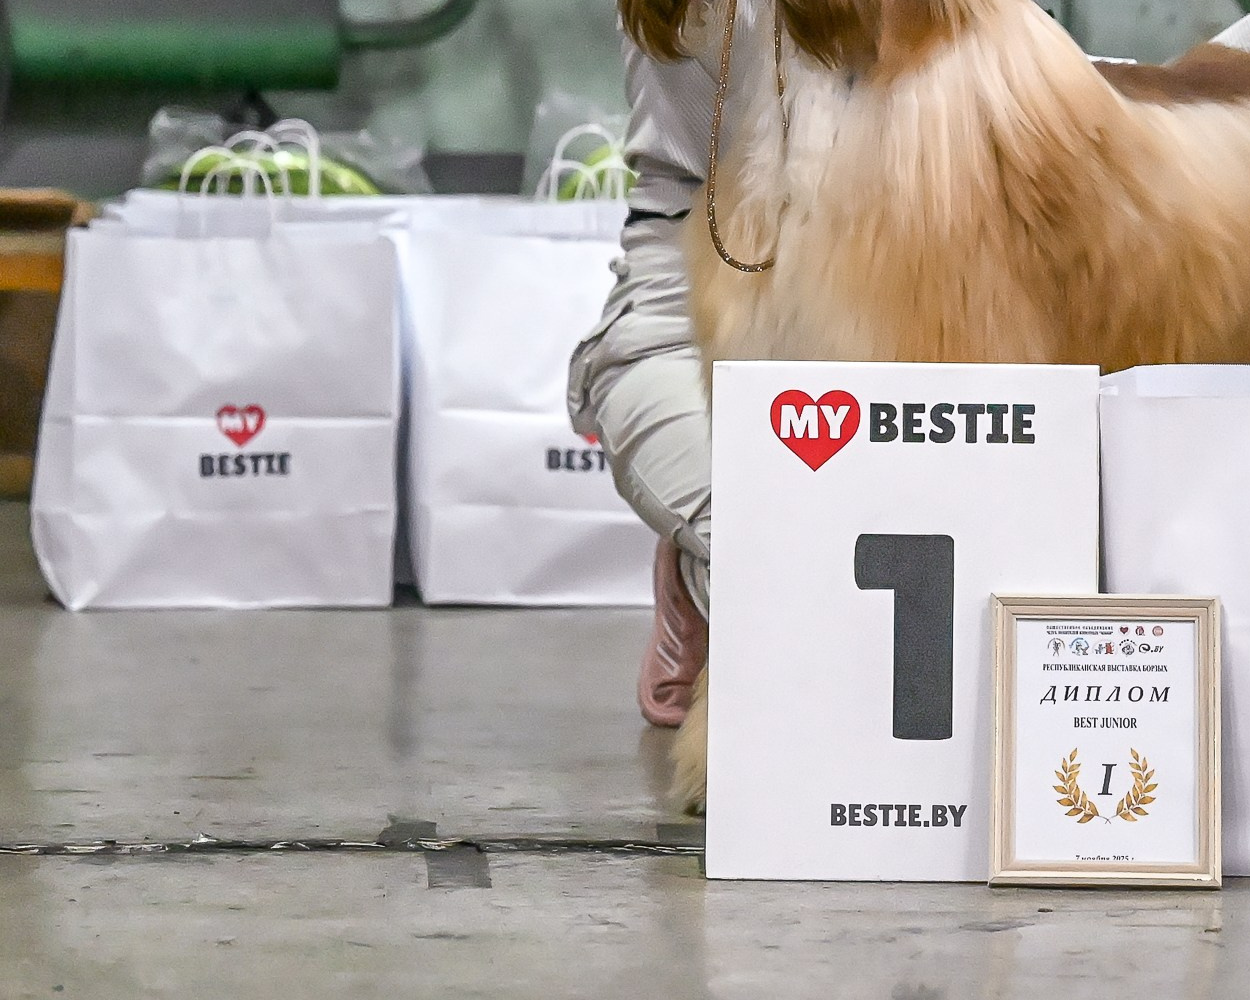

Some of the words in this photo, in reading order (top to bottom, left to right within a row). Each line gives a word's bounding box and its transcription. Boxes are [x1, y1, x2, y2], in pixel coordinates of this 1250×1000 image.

[779, 404, 851, 440] MY
[869, 402, 1036, 445] BESTIE
[200, 452, 292, 478] BESTIE
[547, 448, 606, 472] BEST
[853, 533, 956, 741] 1
[1042, 663, 1106, 673] РЕСПУБЛИКАНСКАЯ
[1107, 664, 1142, 673] ВЫСТАВКА
[1142, 664, 1169, 673] БОРЗЫХ
[1039, 685, 1171, 705] ДИПЛОМ
[1073, 716, 1099, 729] BEST
[1099, 716, 1138, 729] JUNIOR
[1097, 763, 1118, 796] I
[830, 803, 968, 828] BESTIE.BY
